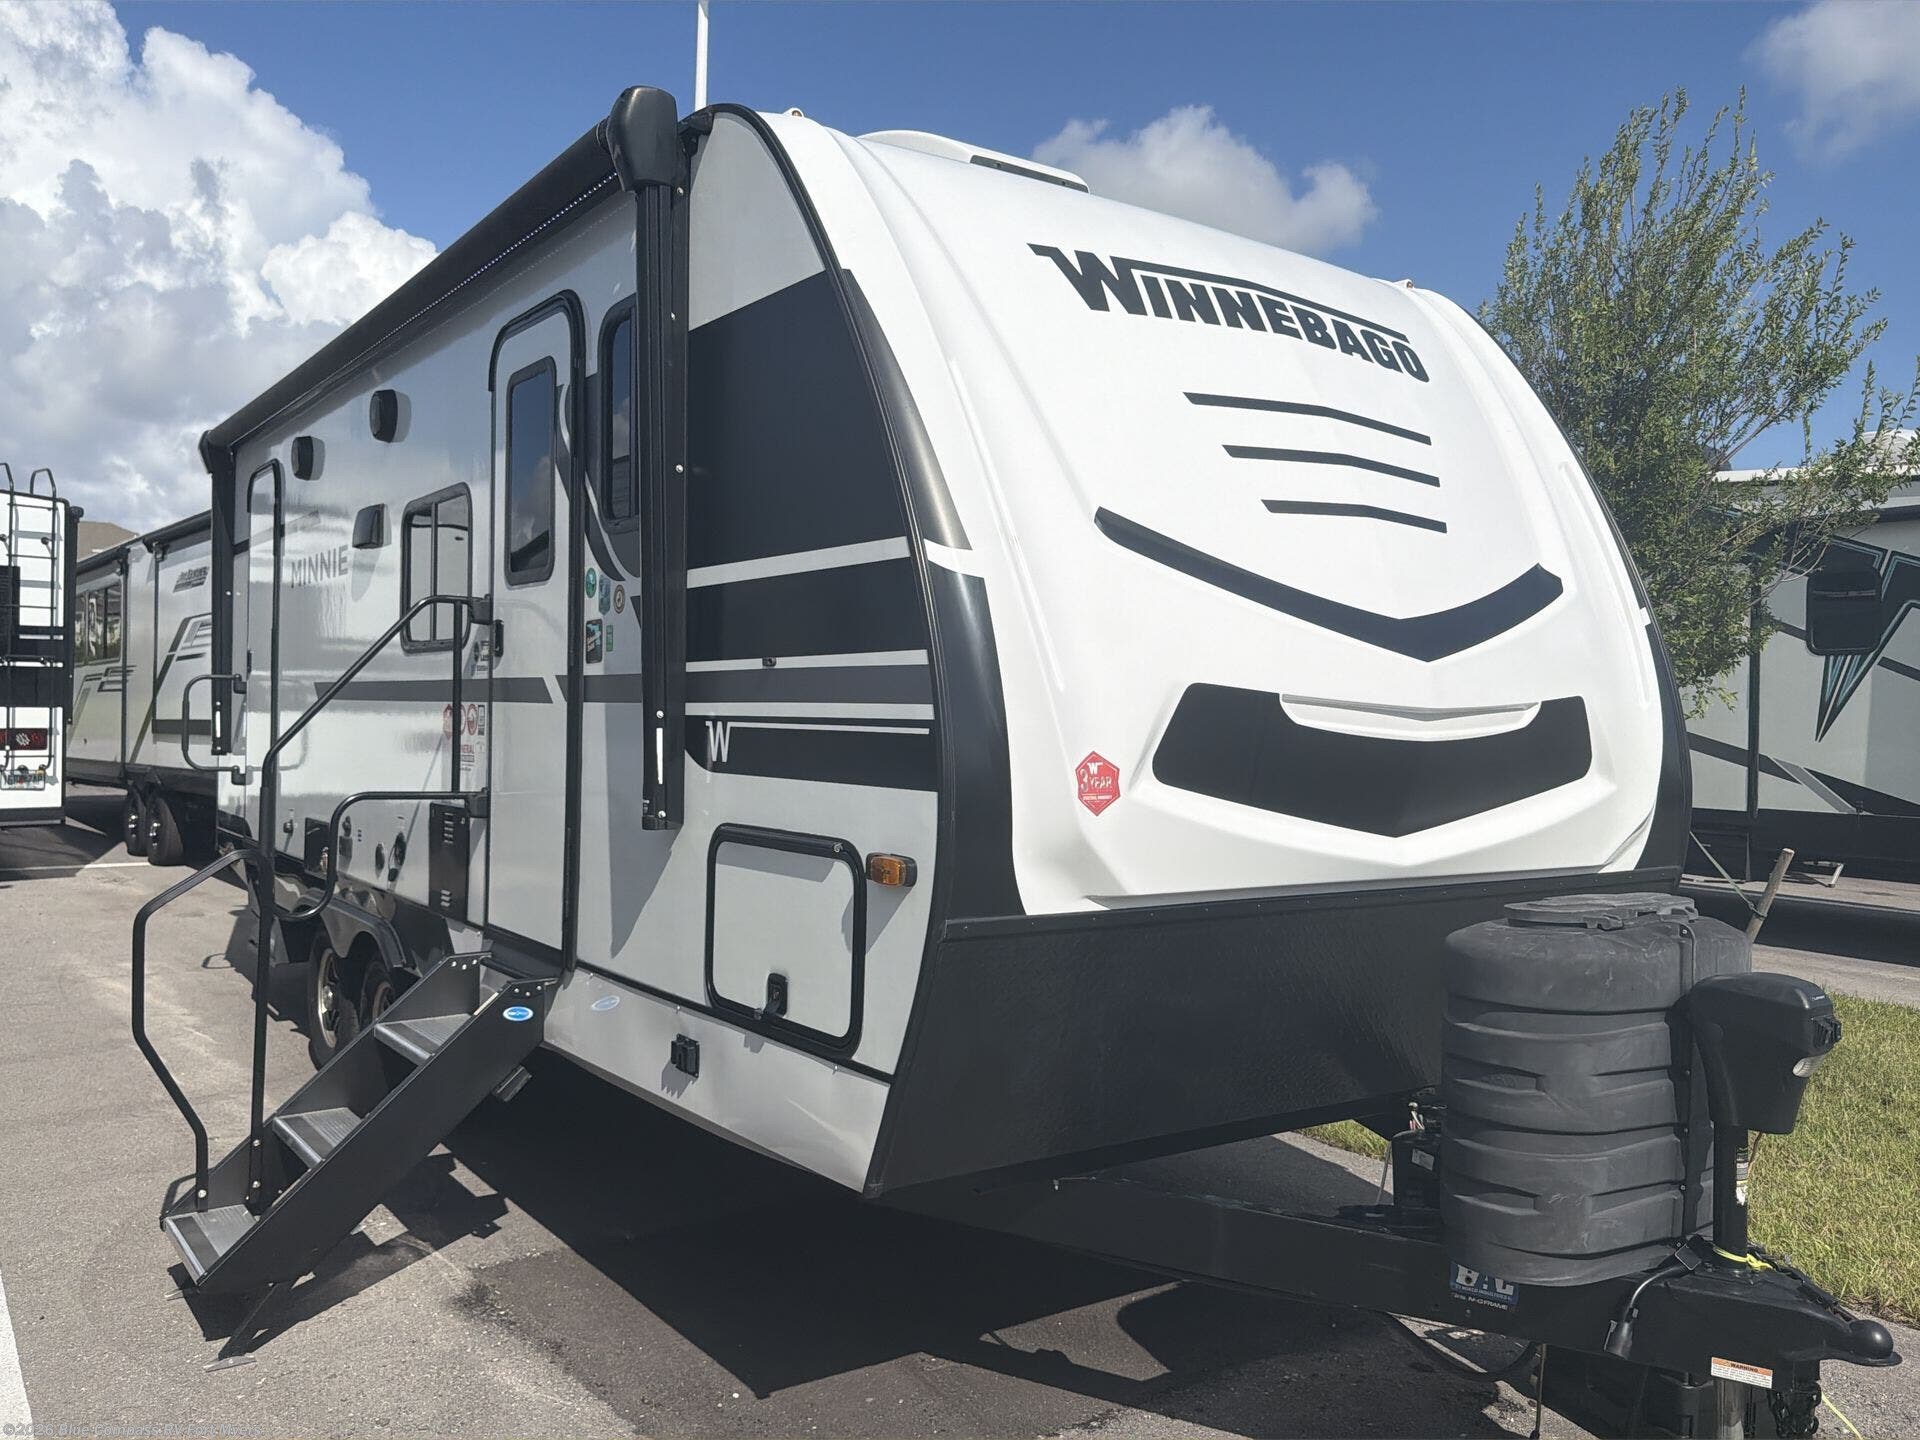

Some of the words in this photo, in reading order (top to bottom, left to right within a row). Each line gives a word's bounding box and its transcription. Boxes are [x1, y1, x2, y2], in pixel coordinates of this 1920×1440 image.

[1027, 243, 1430, 383] WINNEBAGO
[291, 544, 349, 588] MINNIE
[705, 720, 732, 763] W
[1079, 768, 1089, 793] 3
[1089, 775, 1112, 789] YEAR
[1087, 762, 1104, 775] W
[1731, 1363, 1759, 1373] WARNING
